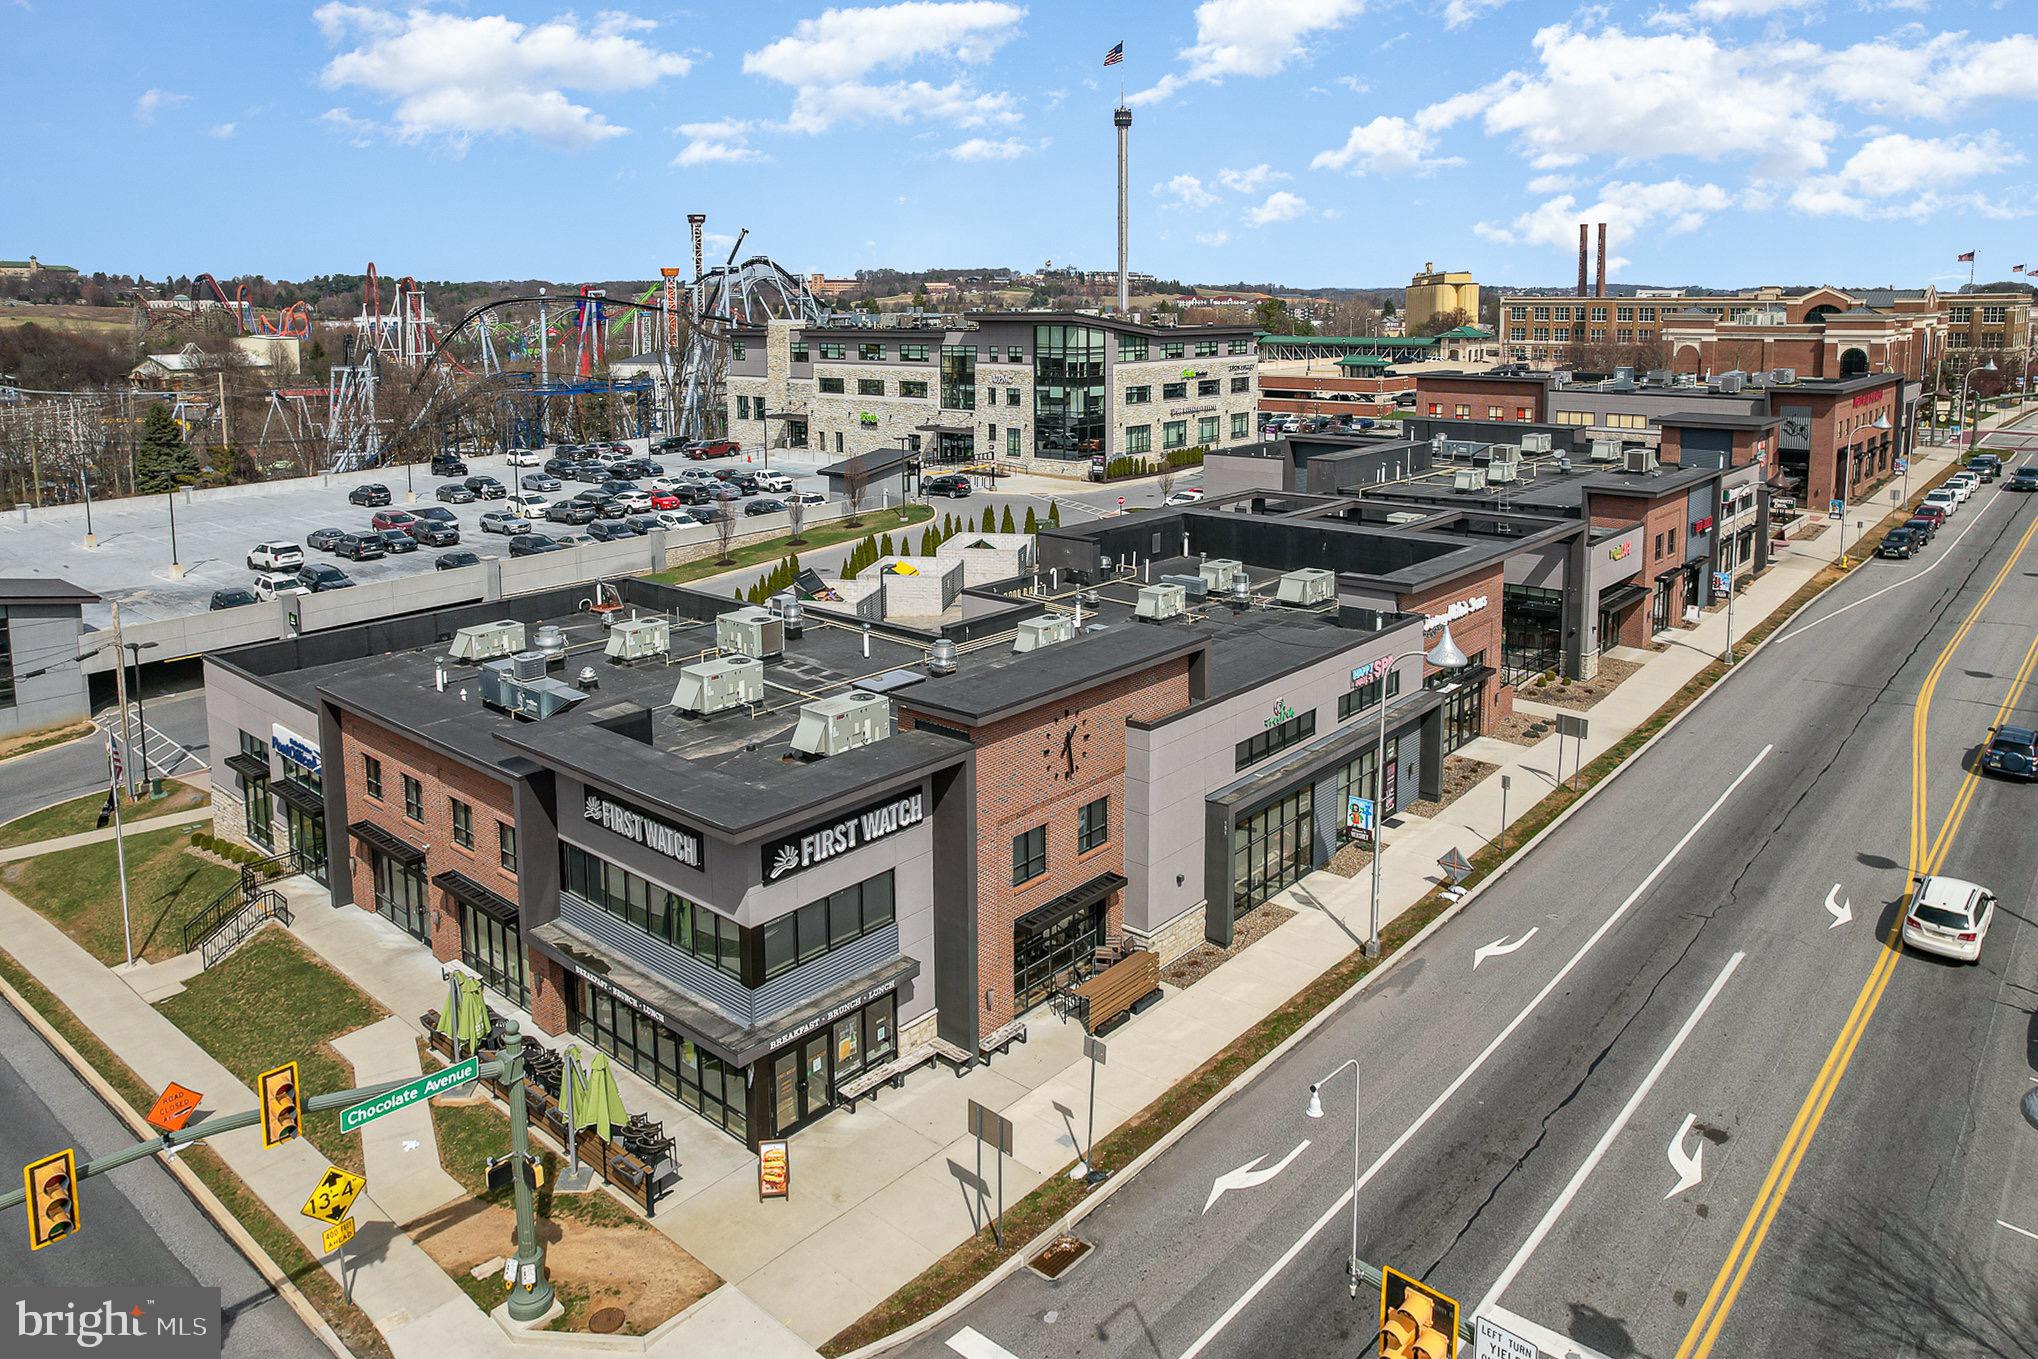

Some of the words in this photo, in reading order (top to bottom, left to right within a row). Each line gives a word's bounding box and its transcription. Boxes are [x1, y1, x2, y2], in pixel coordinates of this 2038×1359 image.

[602, 801, 643, 842] FIRST
[643, 818, 697, 866] WATCH
[801, 818, 859, 867] FIRST
[861, 793, 923, 842] WATCH
[769, 1017, 821, 1051] BREAKFAST
[827, 996, 862, 1021] BRUNCH
[868, 979, 896, 1001] LUNCH
[160, 1098, 190, 1116] CLOSED
[163, 1091, 184, 1105] ROAD
[347, 1089, 418, 1125] Chocolate
[423, 1066, 473, 1095] Avenue
[328, 1231, 353, 1248] AHEAD
[1481, 1324, 1503, 1343] LEFT
[1509, 1338, 1532, 1358] TURN
[1490, 1342, 1520, 1359] YIEL
